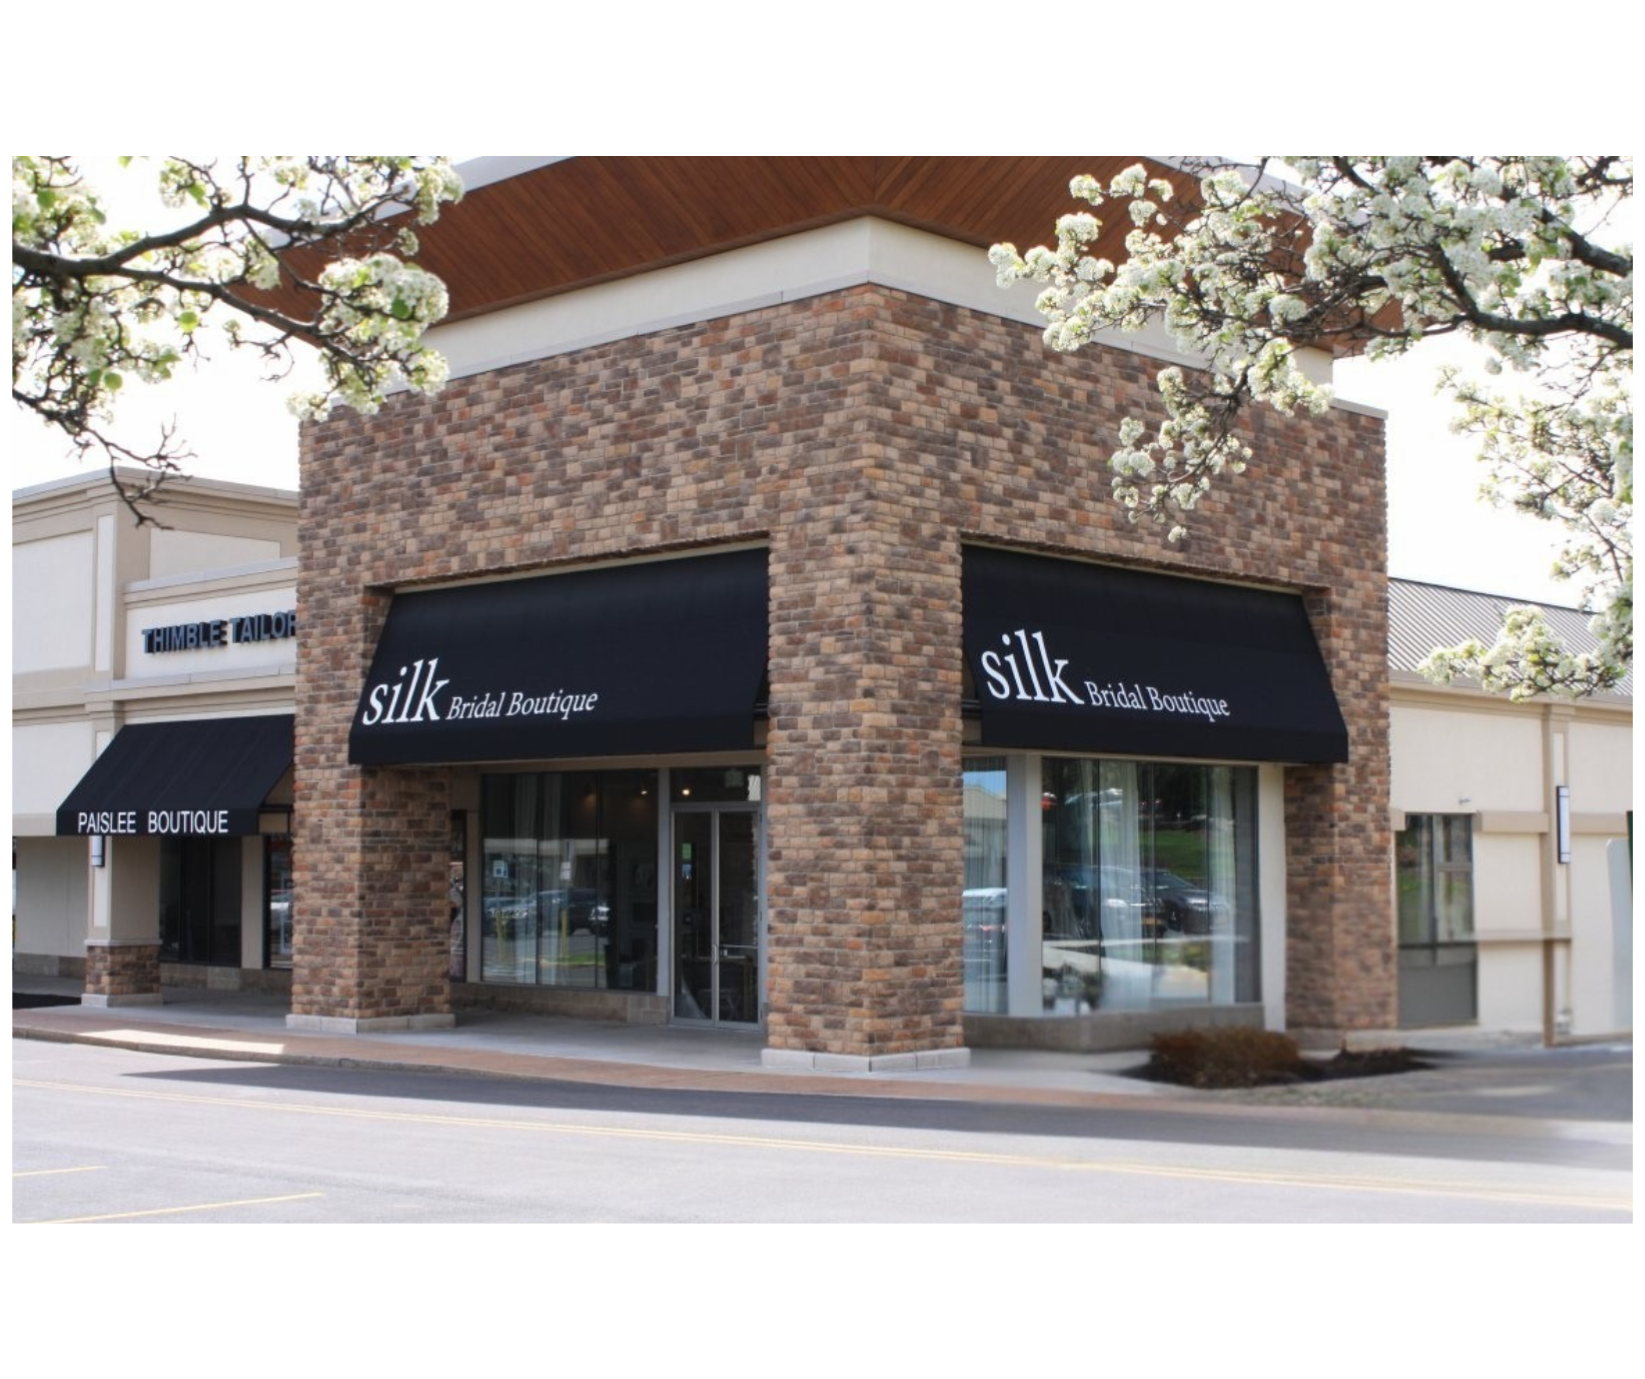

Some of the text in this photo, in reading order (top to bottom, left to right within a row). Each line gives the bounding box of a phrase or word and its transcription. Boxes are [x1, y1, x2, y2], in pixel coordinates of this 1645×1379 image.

[141, 619, 228, 654] THIMBLE
[361, 657, 599, 726] silk Bridal Boutique
[980, 628, 1231, 724] silk Bridal Boutique
[77, 810, 229, 834] PAISLEE BOUTIQUE
